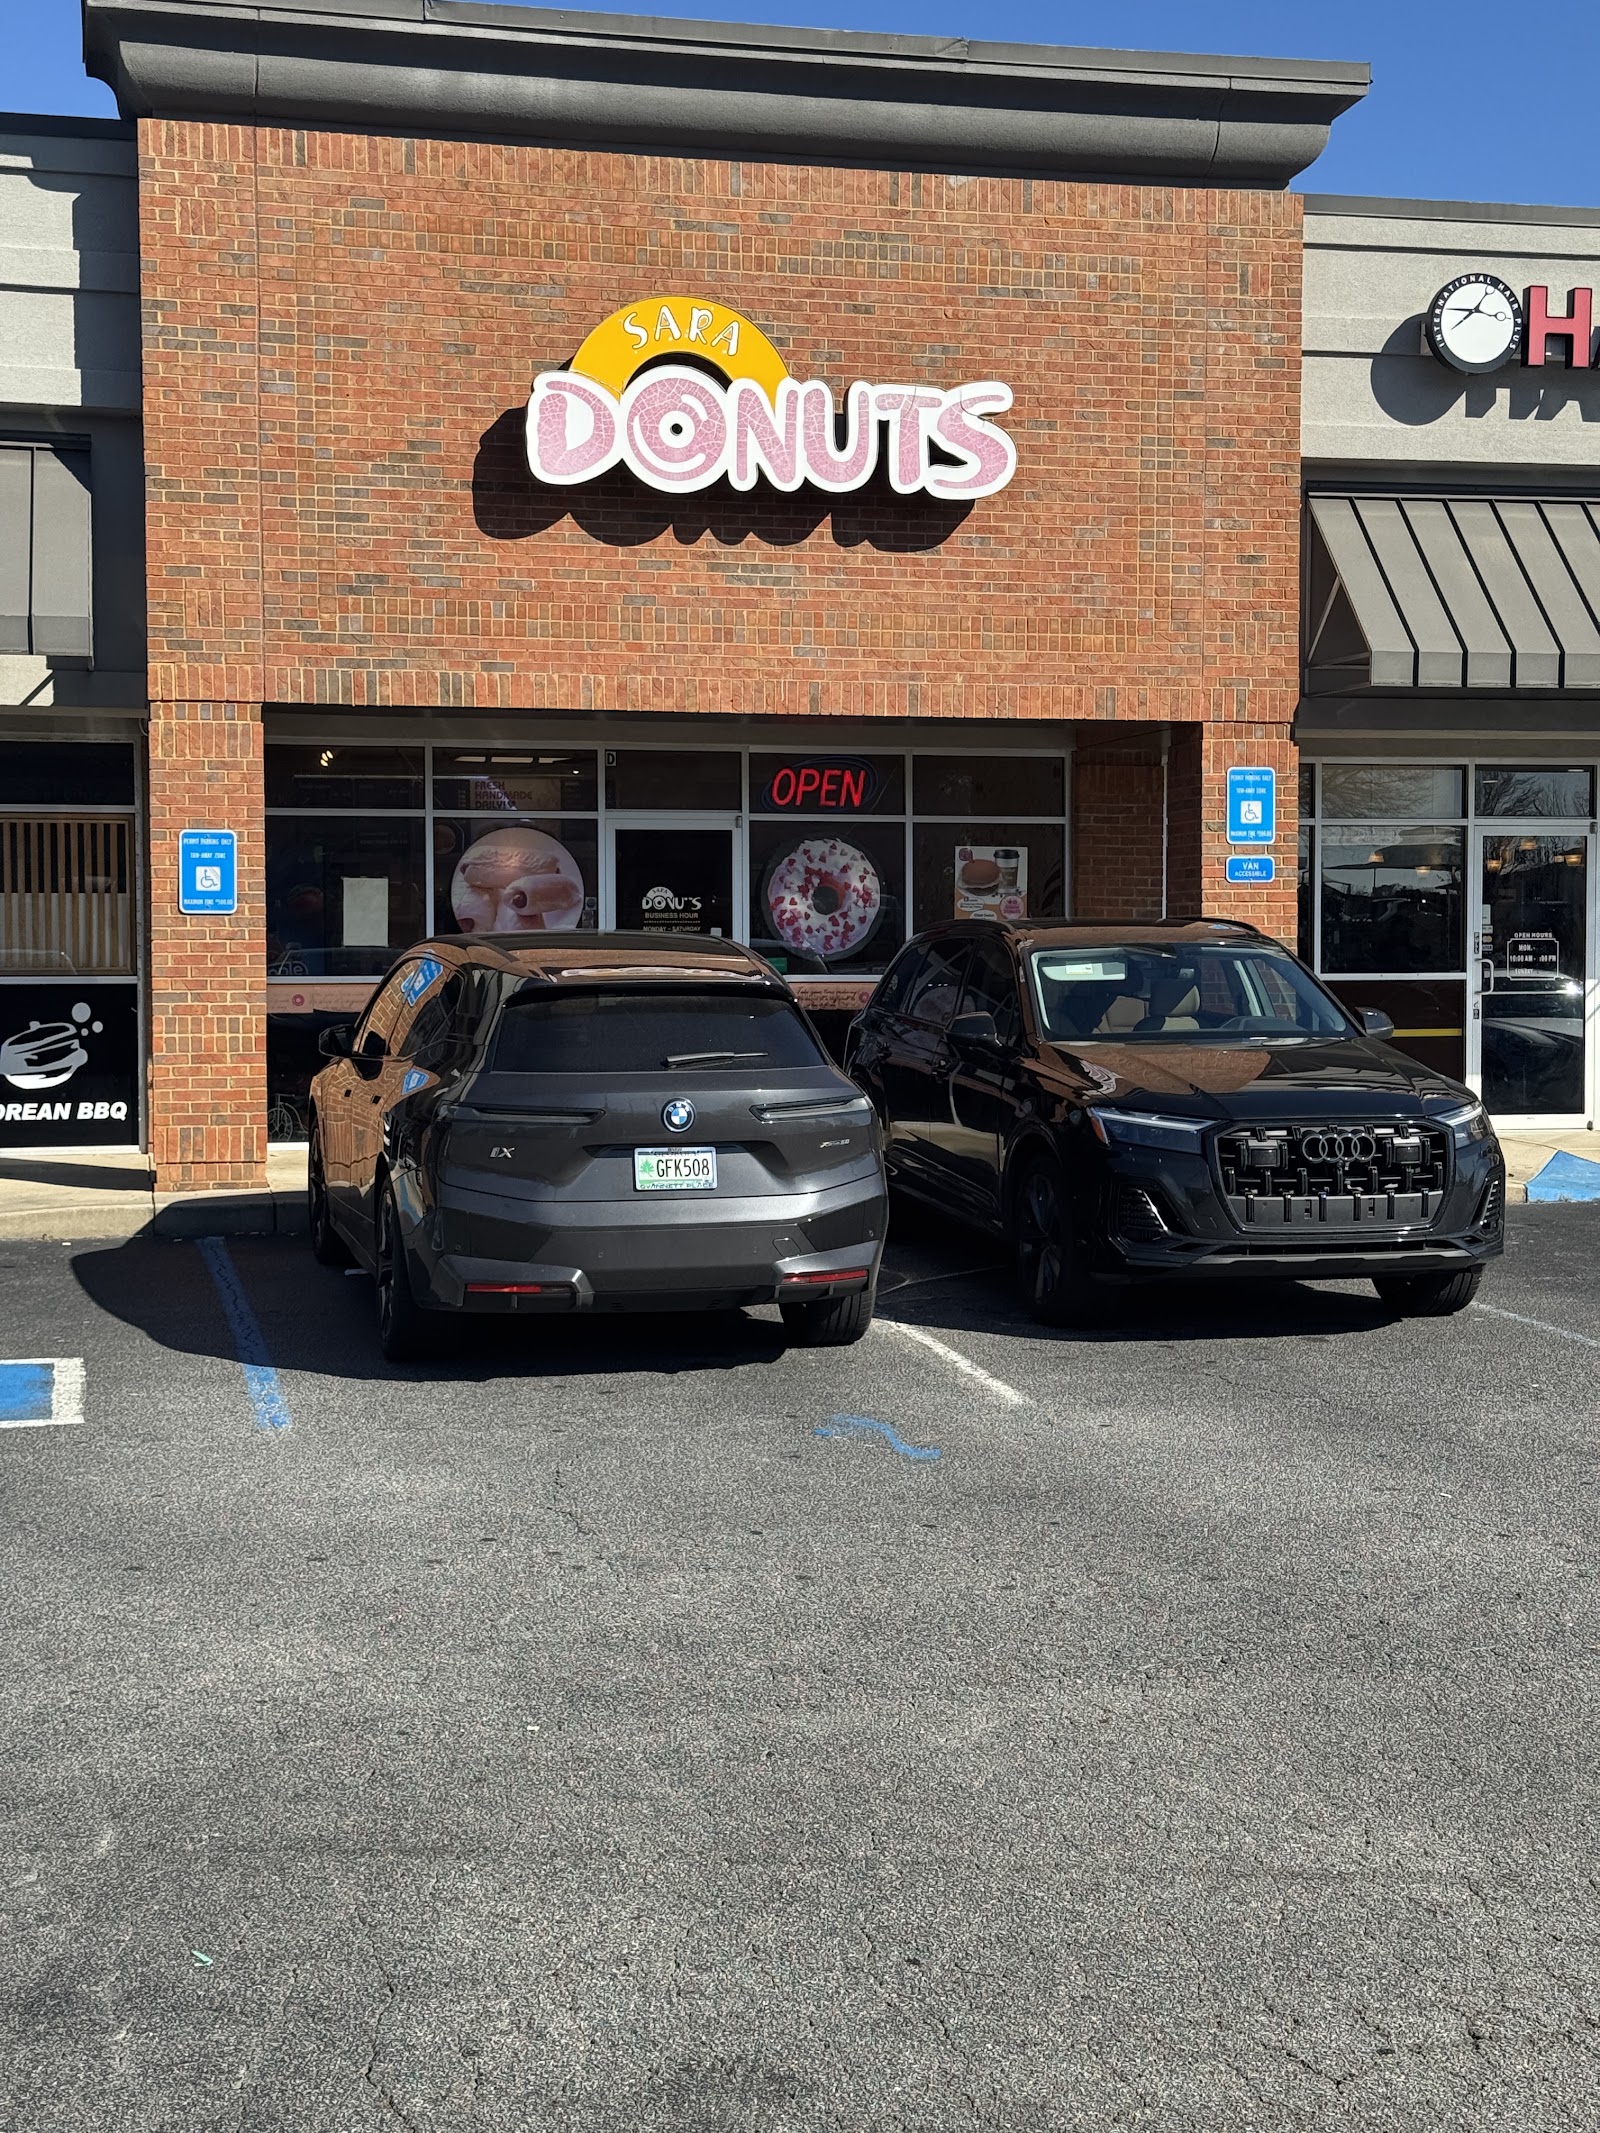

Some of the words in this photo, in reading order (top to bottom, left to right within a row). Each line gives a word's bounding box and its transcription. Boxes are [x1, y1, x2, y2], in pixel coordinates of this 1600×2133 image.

[1433, 275, 1491, 347] INTERNATIONAL
[1498, 283, 1518, 310] HAIR
[1510, 318, 1522, 350] PLUS
[623, 305, 740, 357] SARA
[1523, 285, 1600, 369] H
[527, 364, 1017, 500] DONUTS
[607, 752, 615, 765] D
[474, 781, 505, 790] FRESH
[771, 767, 866, 807] OPEN
[474, 791, 533, 800] HANDMADE
[1242, 862, 1259, 870] VAN
[76, 1102, 128, 1121] BBQ
[656, 1159, 709, 1177] GFK508
